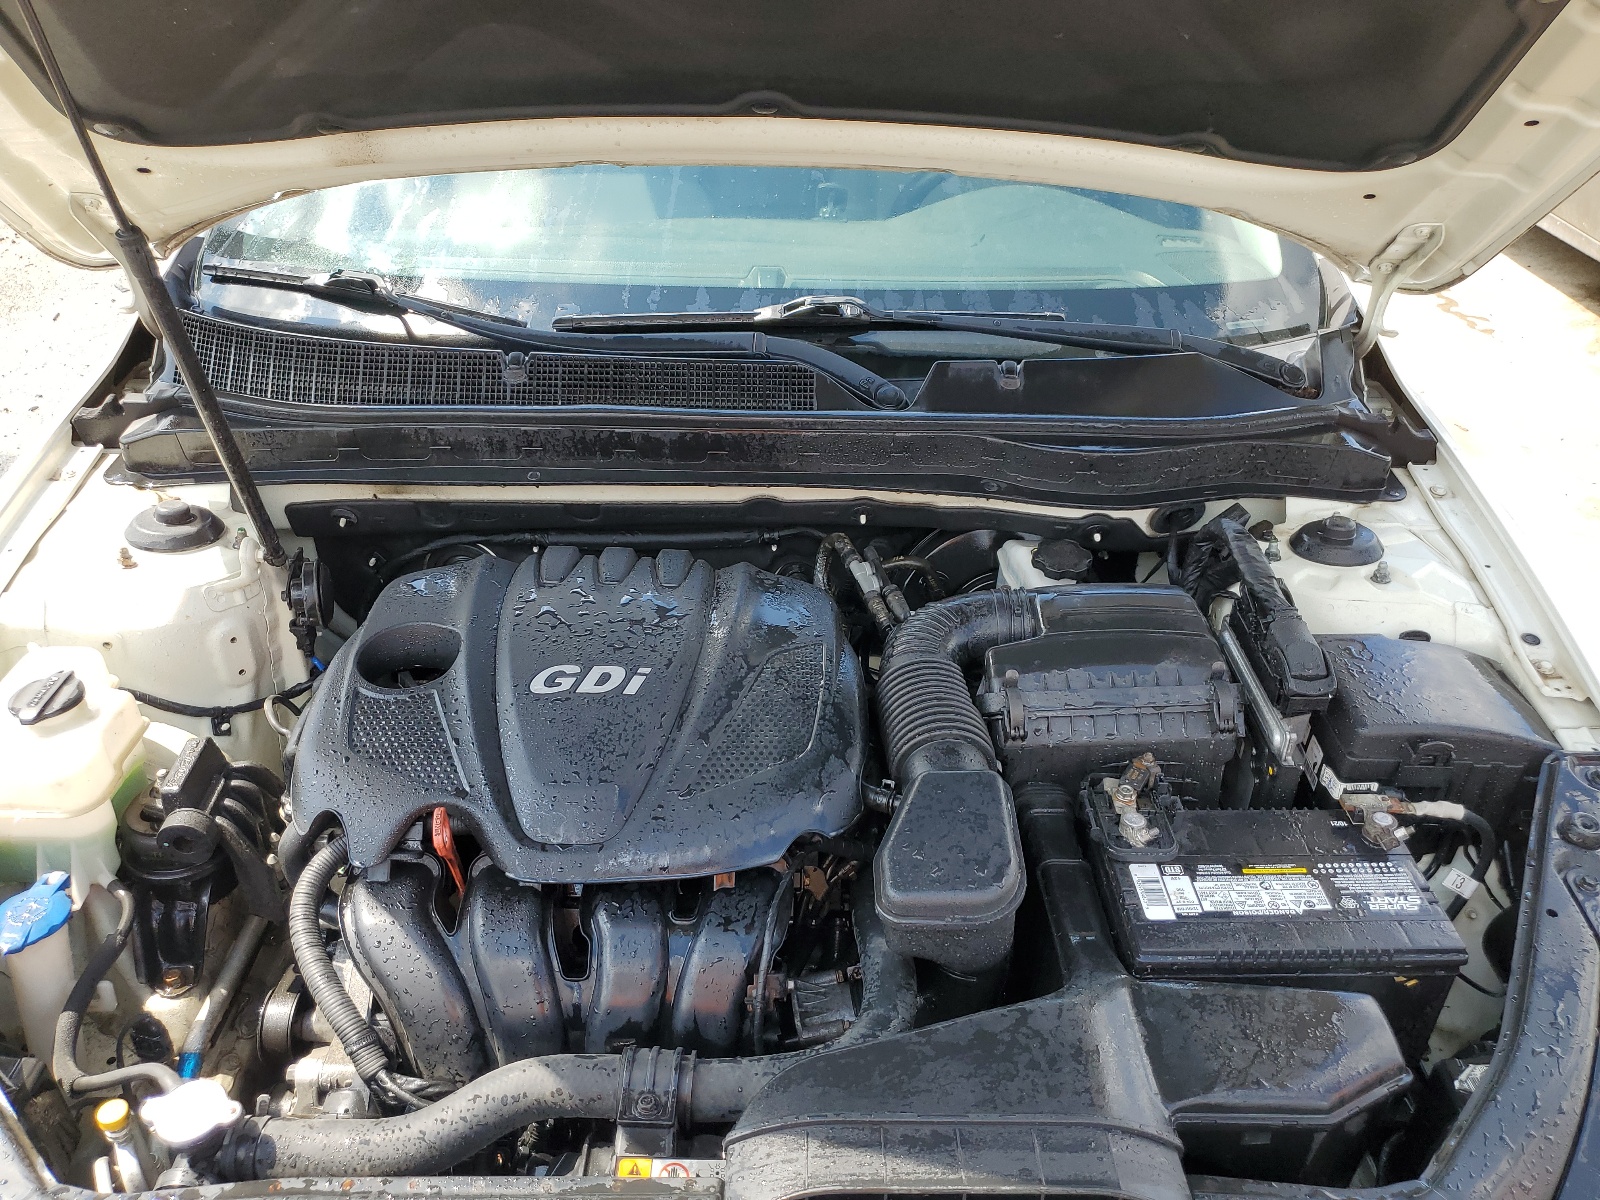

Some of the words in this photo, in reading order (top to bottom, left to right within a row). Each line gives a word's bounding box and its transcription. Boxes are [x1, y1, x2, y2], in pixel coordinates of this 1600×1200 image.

[529, 664, 652, 695] GDi
[1451, 873, 1466, 889] T3
[1368, 895, 1421, 904] START
[1369, 903, 1418, 911] SUPER
